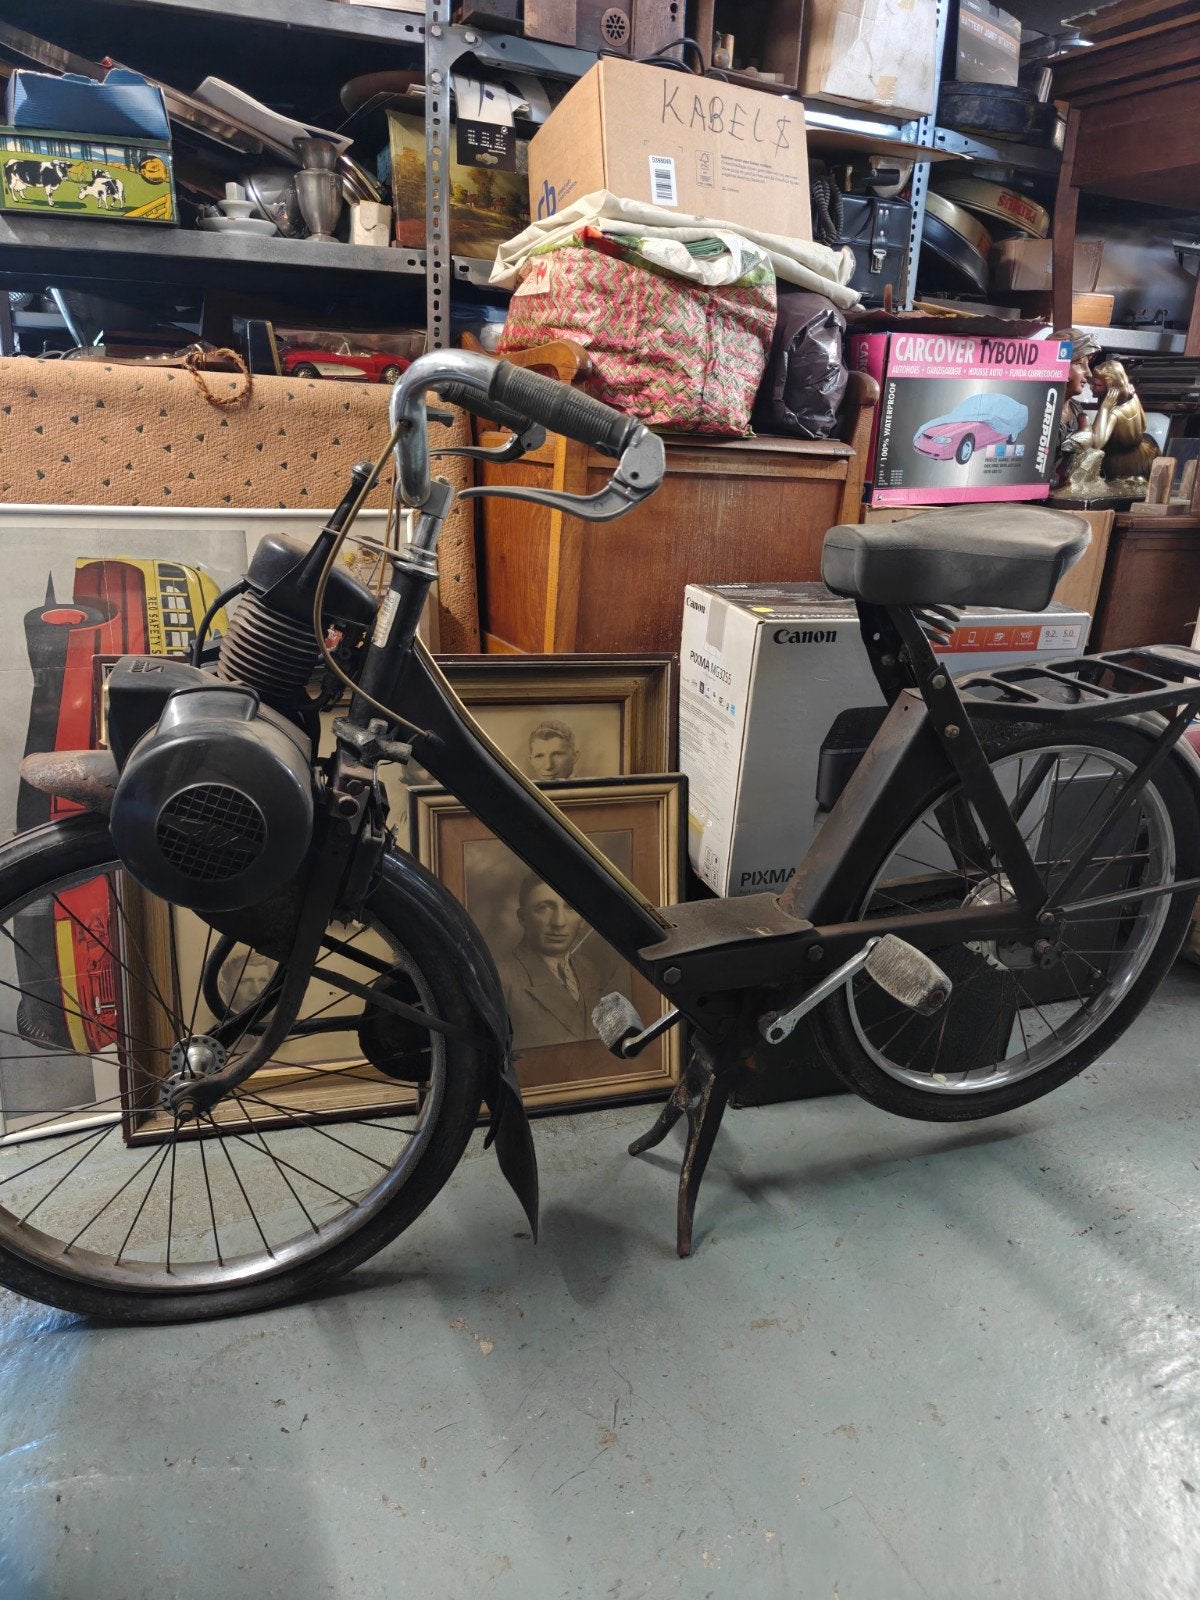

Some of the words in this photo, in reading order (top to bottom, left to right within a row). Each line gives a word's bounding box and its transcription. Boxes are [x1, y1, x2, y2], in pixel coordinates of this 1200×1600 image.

[895, 337, 976, 364] CARCOVER
[980, 338, 1039, 366] TYBOND
[883, 382, 897, 437] WATERPROOF
[880, 437, 890, 461] 100%
[686, 596, 706, 614] Canon
[149, 613, 161, 646] SAFETY
[773, 628, 838, 645] Canon
[689, 650, 710, 672] PIXMA
